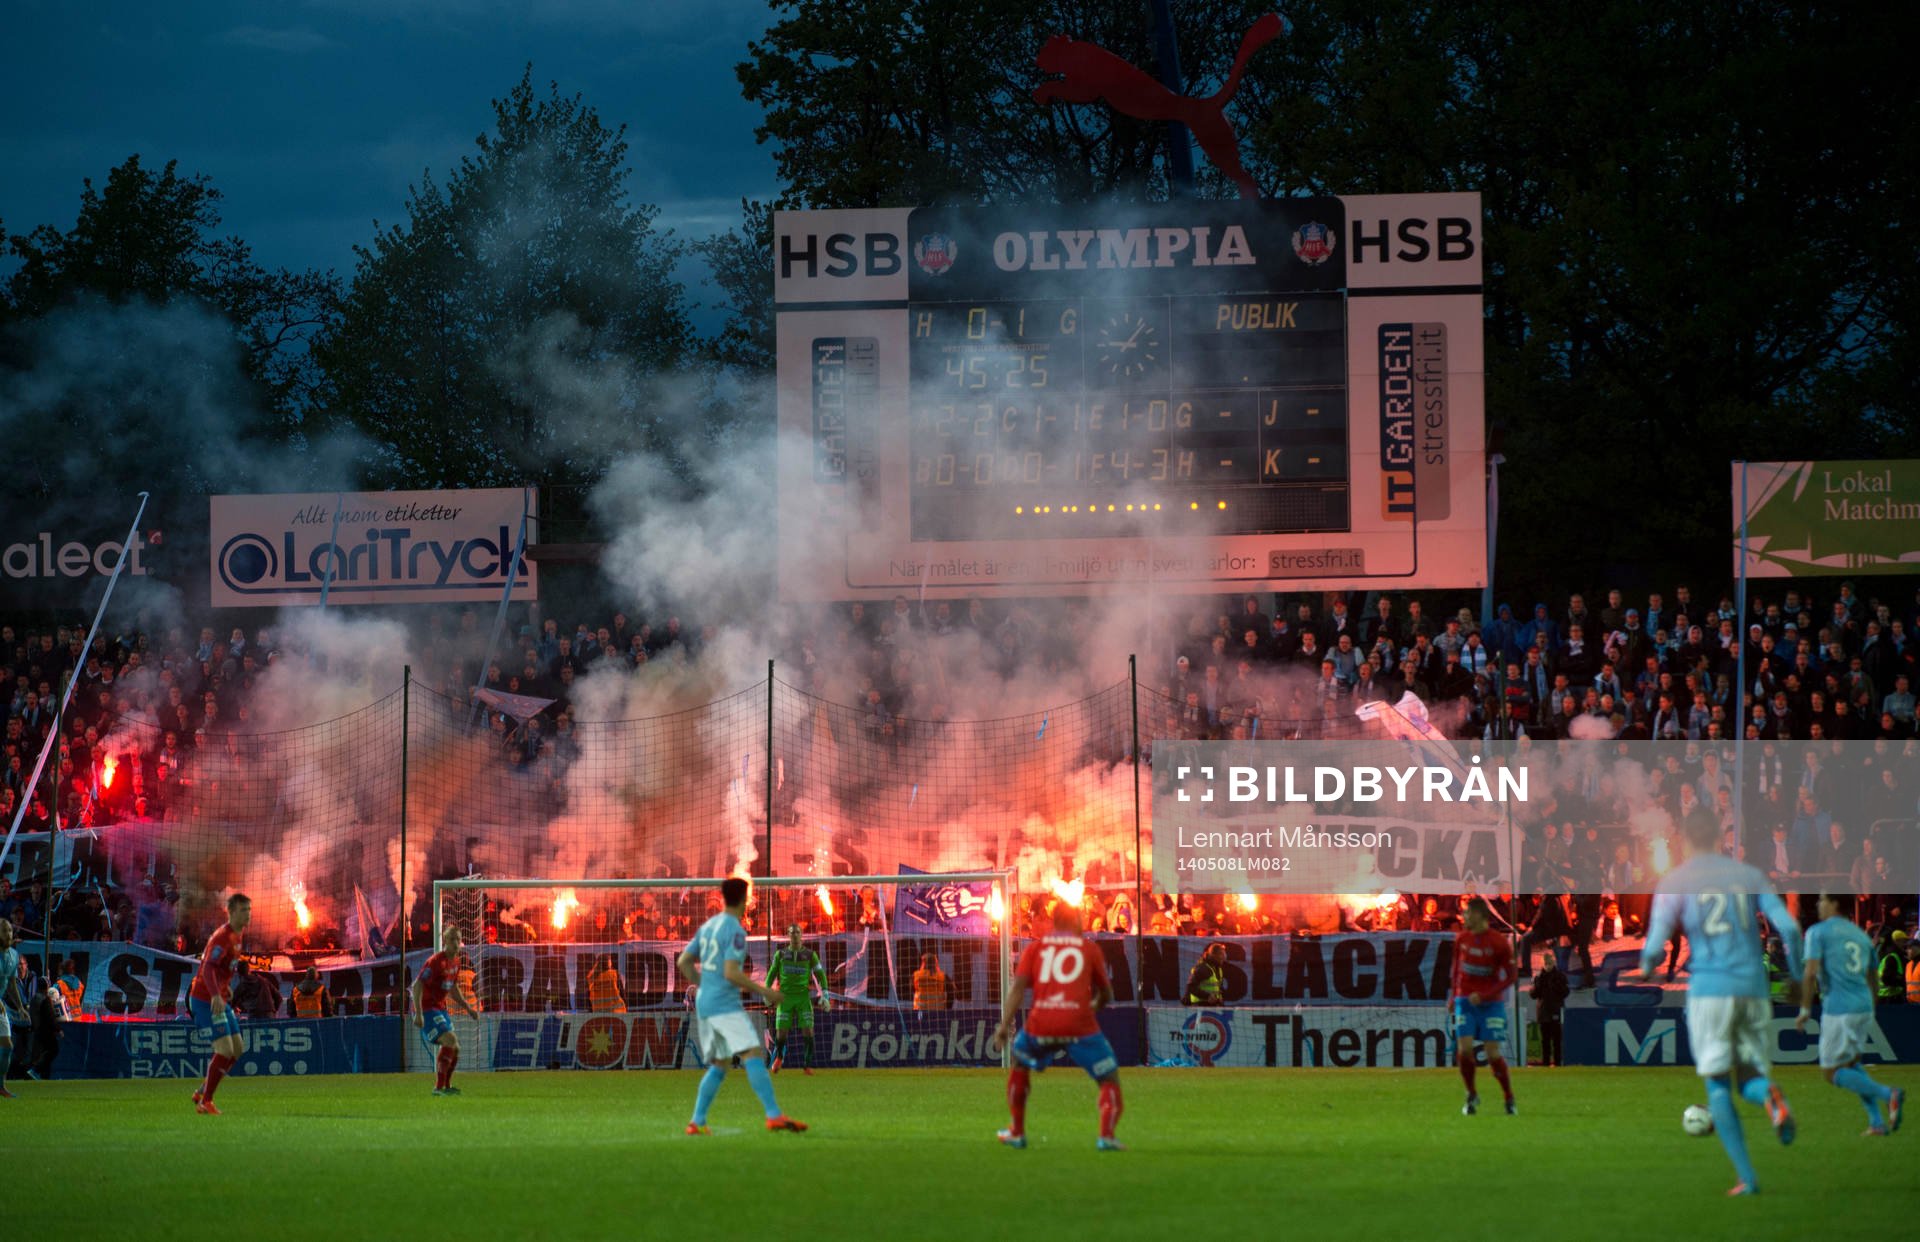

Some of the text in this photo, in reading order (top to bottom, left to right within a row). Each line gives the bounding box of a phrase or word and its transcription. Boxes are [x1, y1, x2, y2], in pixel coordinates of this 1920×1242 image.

[780, 232, 902, 279] HSB
[993, 225, 1256, 272] OLYMPIA
[1352, 217, 1475, 264] HSB
[916, 312, 933, 337] H
[1059, 309, 1076, 335] G
[1216, 302, 1299, 330] PUBLIK
[818, 345, 845, 476] GARDEN
[1175, 402, 1193, 428] G
[1265, 399, 1278, 426] J
[1416, 329, 1444, 465] stressfri.it
[1384, 331, 1414, 513] IT GARDEN
[1177, 450, 1195, 477] H
[1264, 449, 1281, 475] K
[1824, 470, 1893, 493] Lokal
[291, 504, 329, 525] Allt
[385, 501, 462, 523] etiketter
[284, 525, 529, 585] LariTryck
[889, 559, 926, 577] När
[931, 558, 979, 577] målet
[1271, 550, 1361, 569] stressfri.it
[1039, 945, 1084, 984] 10
[1845, 940, 1862, 973] 3
[493, 1016, 688, 1071] ELON
[131, 1060, 211, 1079] BAN
